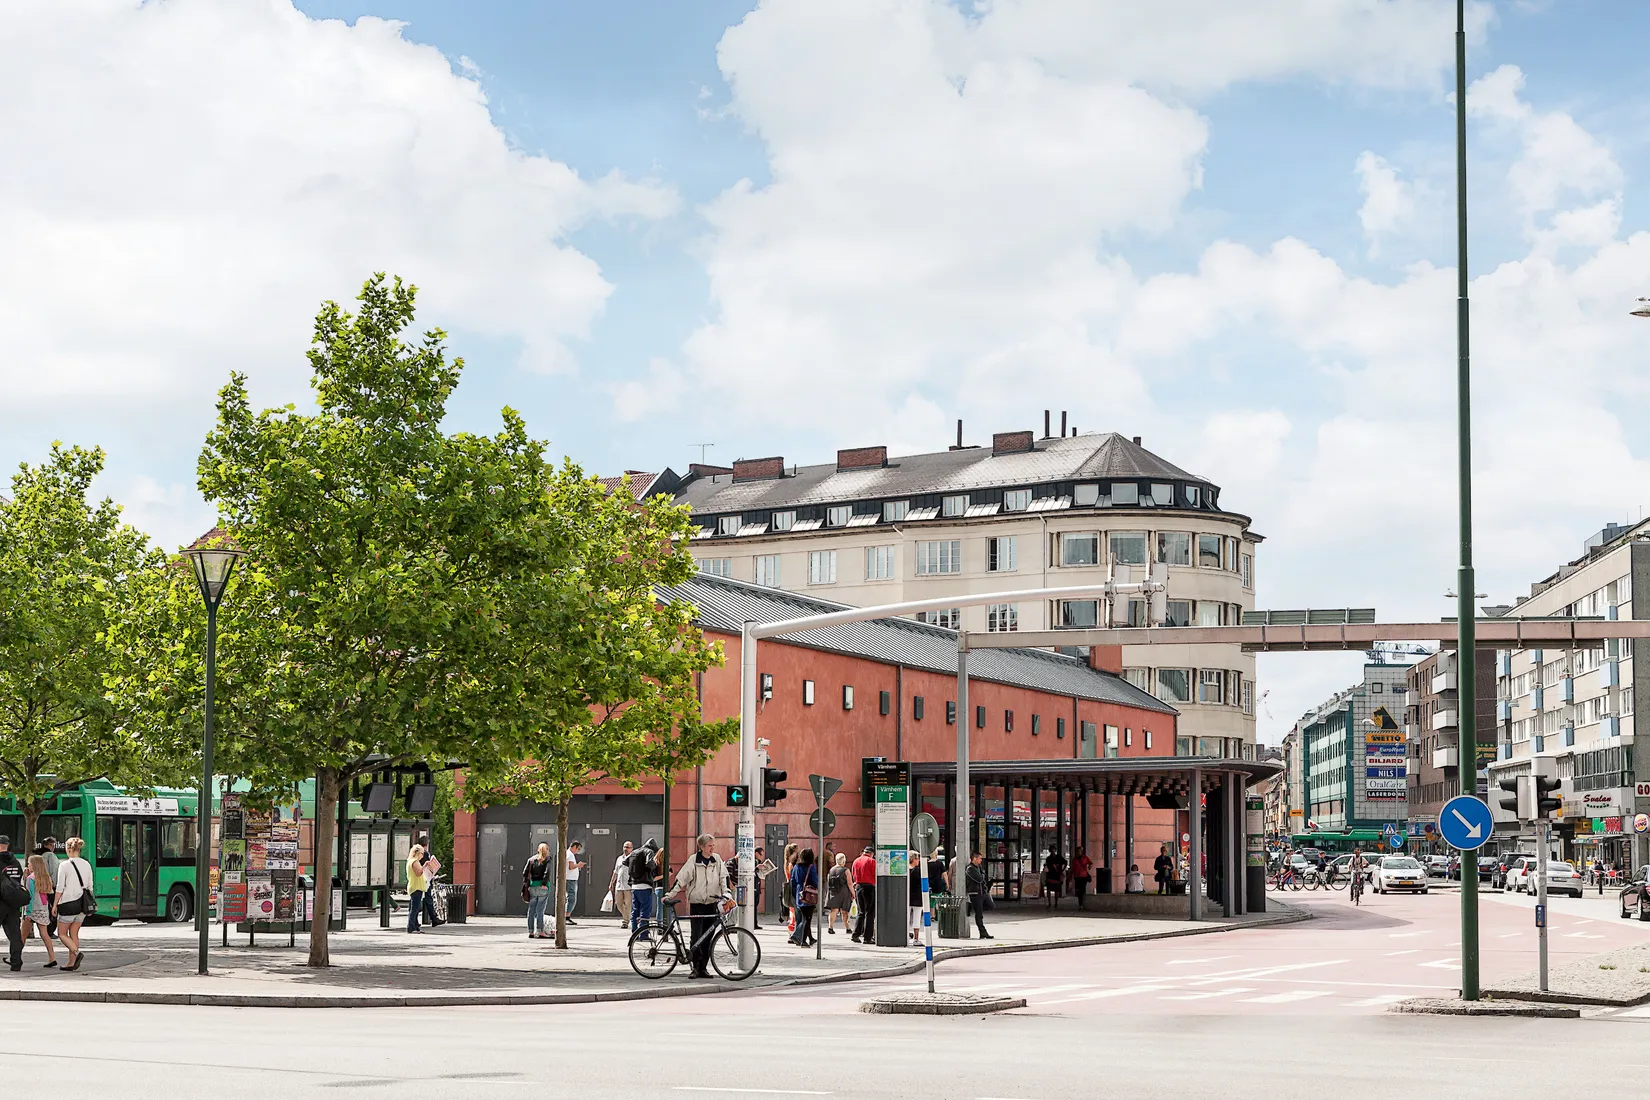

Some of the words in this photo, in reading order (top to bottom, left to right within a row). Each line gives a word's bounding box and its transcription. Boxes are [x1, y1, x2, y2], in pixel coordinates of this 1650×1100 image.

[1378, 769, 1394, 777] NILS
[888, 792, 894, 801] F
[1583, 794, 1612, 802] Svalan
